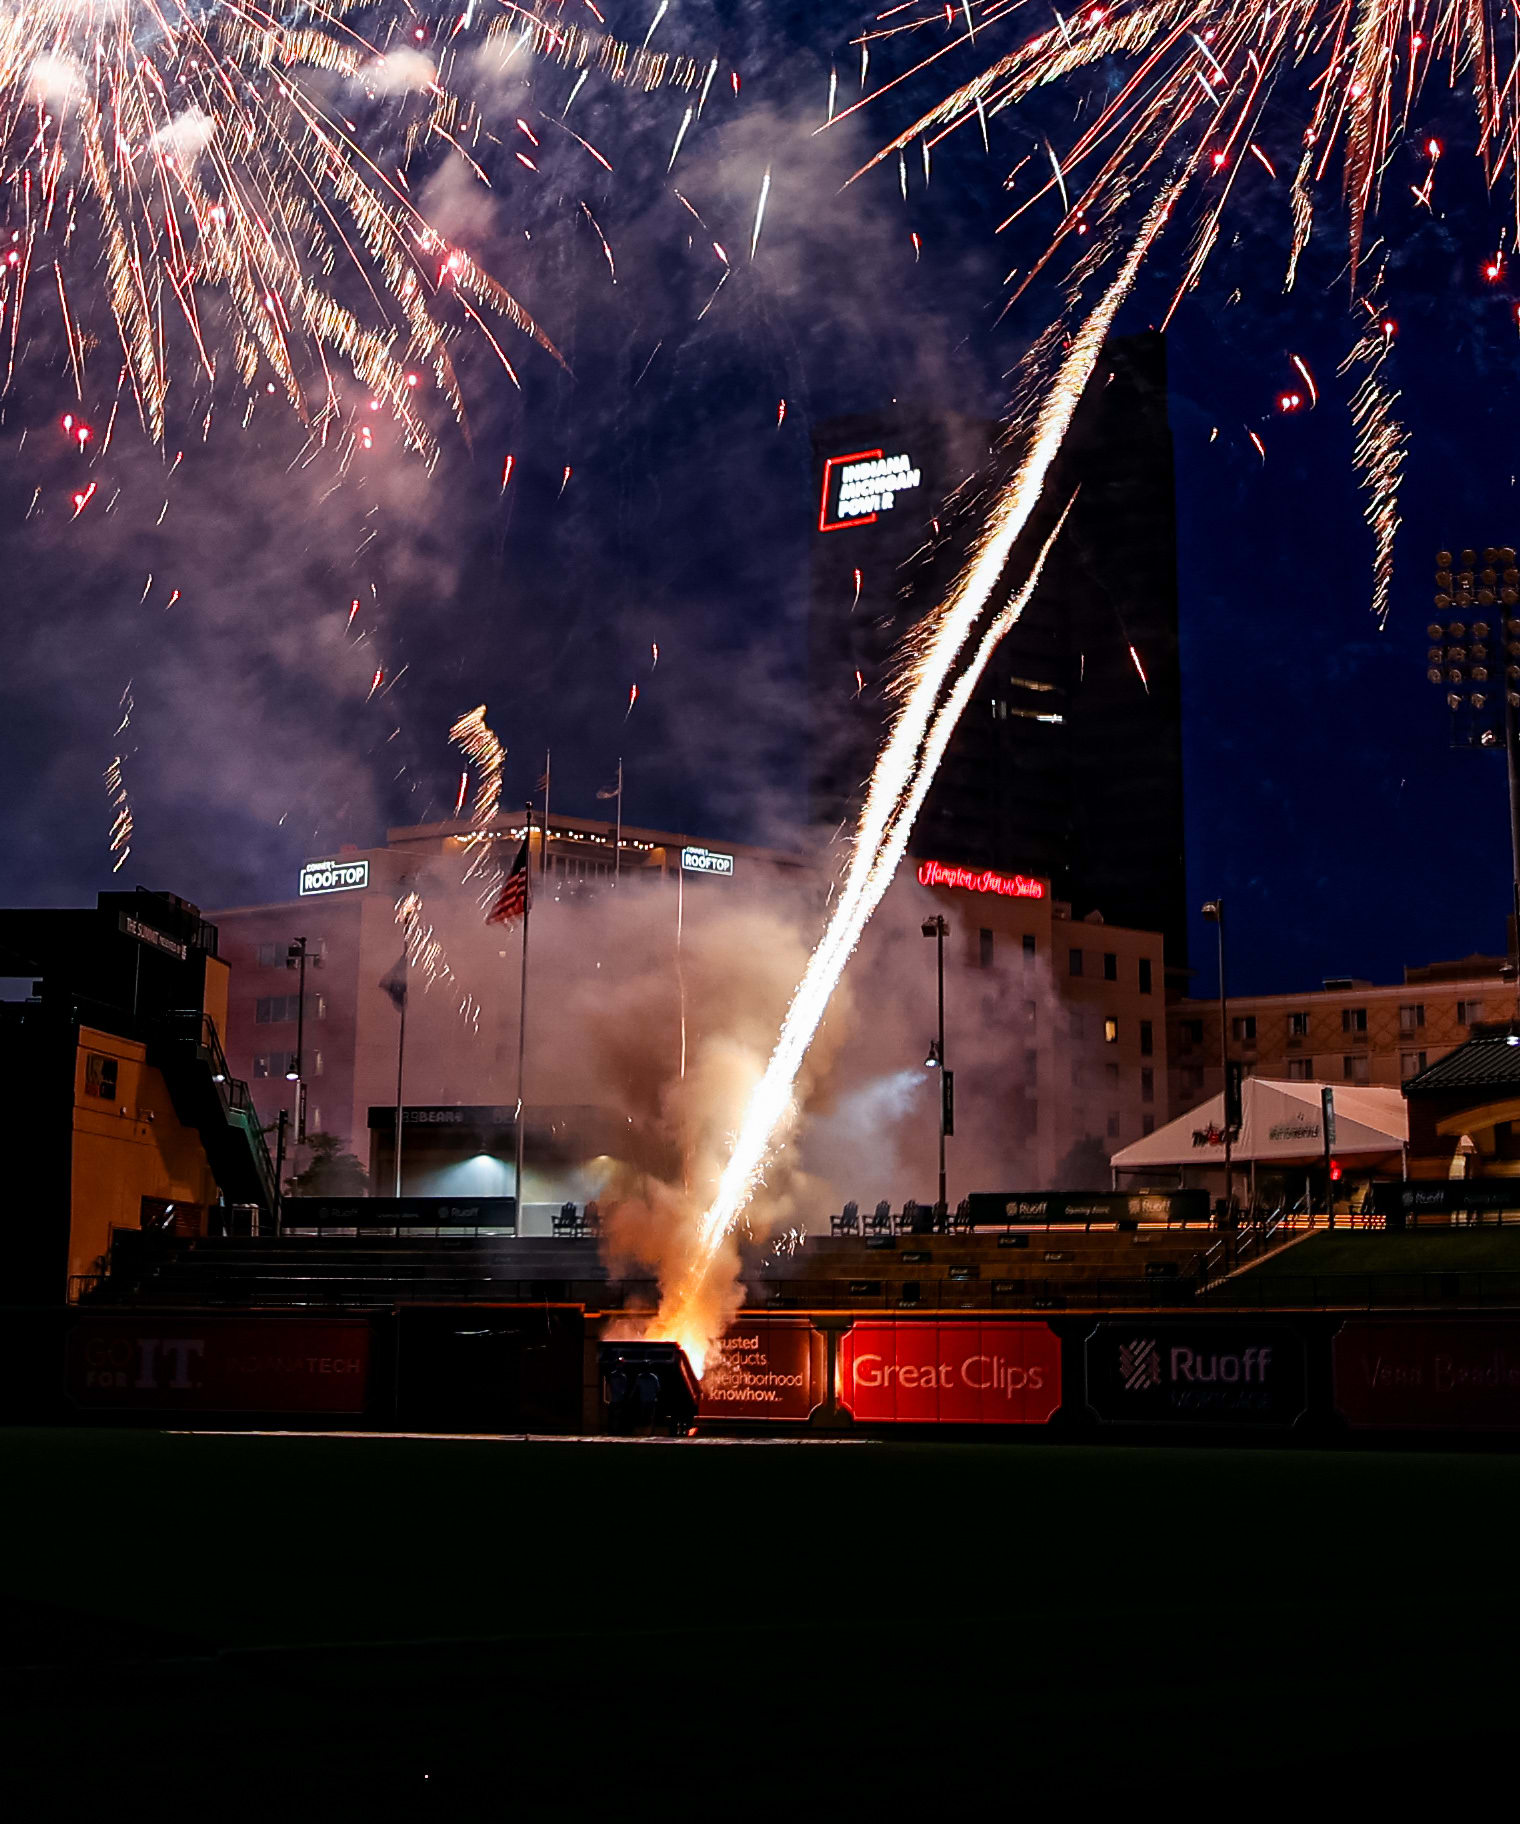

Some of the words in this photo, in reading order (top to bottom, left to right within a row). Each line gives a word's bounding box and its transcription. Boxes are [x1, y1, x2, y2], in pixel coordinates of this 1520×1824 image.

[842, 455, 910, 483] INDIANA
[685, 853, 730, 871] ROOFTOP
[305, 866, 365, 890] ROOFTOP
[918, 860, 977, 891] Hampton
[976, 871, 1003, 895] Inn
[853, 1353, 955, 1389] Great
[961, 1354, 1044, 1400] Clips
[1169, 1344, 1273, 1383] Ruoff
[85, 1371, 128, 1389] FOR
